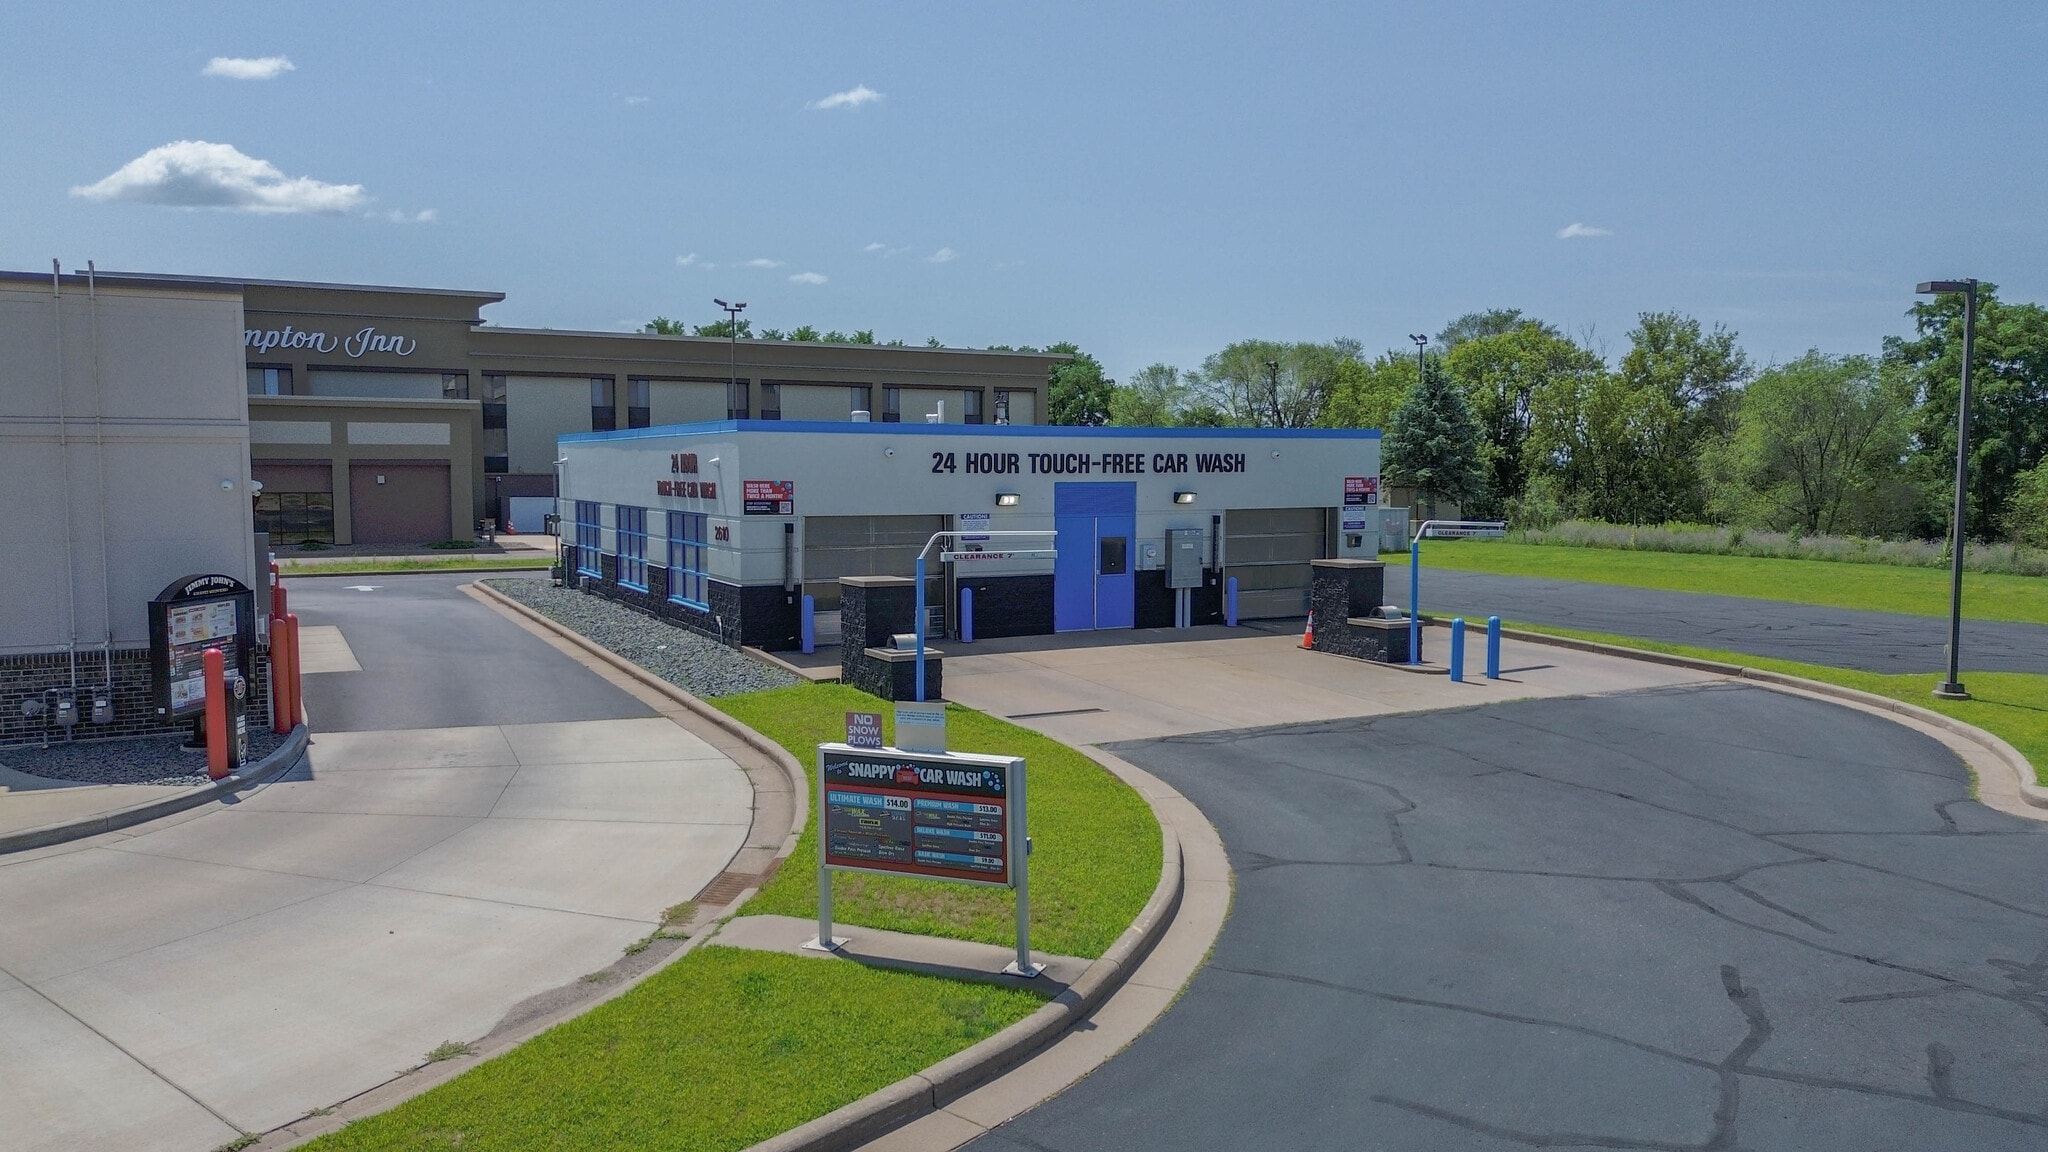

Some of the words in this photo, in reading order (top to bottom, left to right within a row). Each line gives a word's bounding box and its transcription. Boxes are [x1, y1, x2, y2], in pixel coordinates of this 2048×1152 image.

[344, 327, 416, 358] Inn
[931, 452, 957, 474] 24
[965, 452, 1020, 474] HOUR
[1027, 453, 1145, 474] TOUCH-FREE
[1152, 453, 1188, 474] CAR
[1195, 453, 1246, 473] WASH
[714, 525, 730, 542] 2610
[953, 552, 1004, 560] CLEARANCE
[184, 577, 210, 596] JIMMY
[210, 576, 236, 588] JOHN'S
[853, 714, 874, 726] NO
[848, 725, 880, 736] SNOW
[847, 735, 881, 746] PLOWS
[848, 762, 896, 780] SNAPPY
[919, 767, 944, 785] CAR
[946, 769, 982, 787] WASH
[829, 793, 861, 804] ULTIMATE
[862, 796, 883, 806] WASH
[886, 798, 909, 809] $14.00
[979, 805, 998, 813] $13.00
